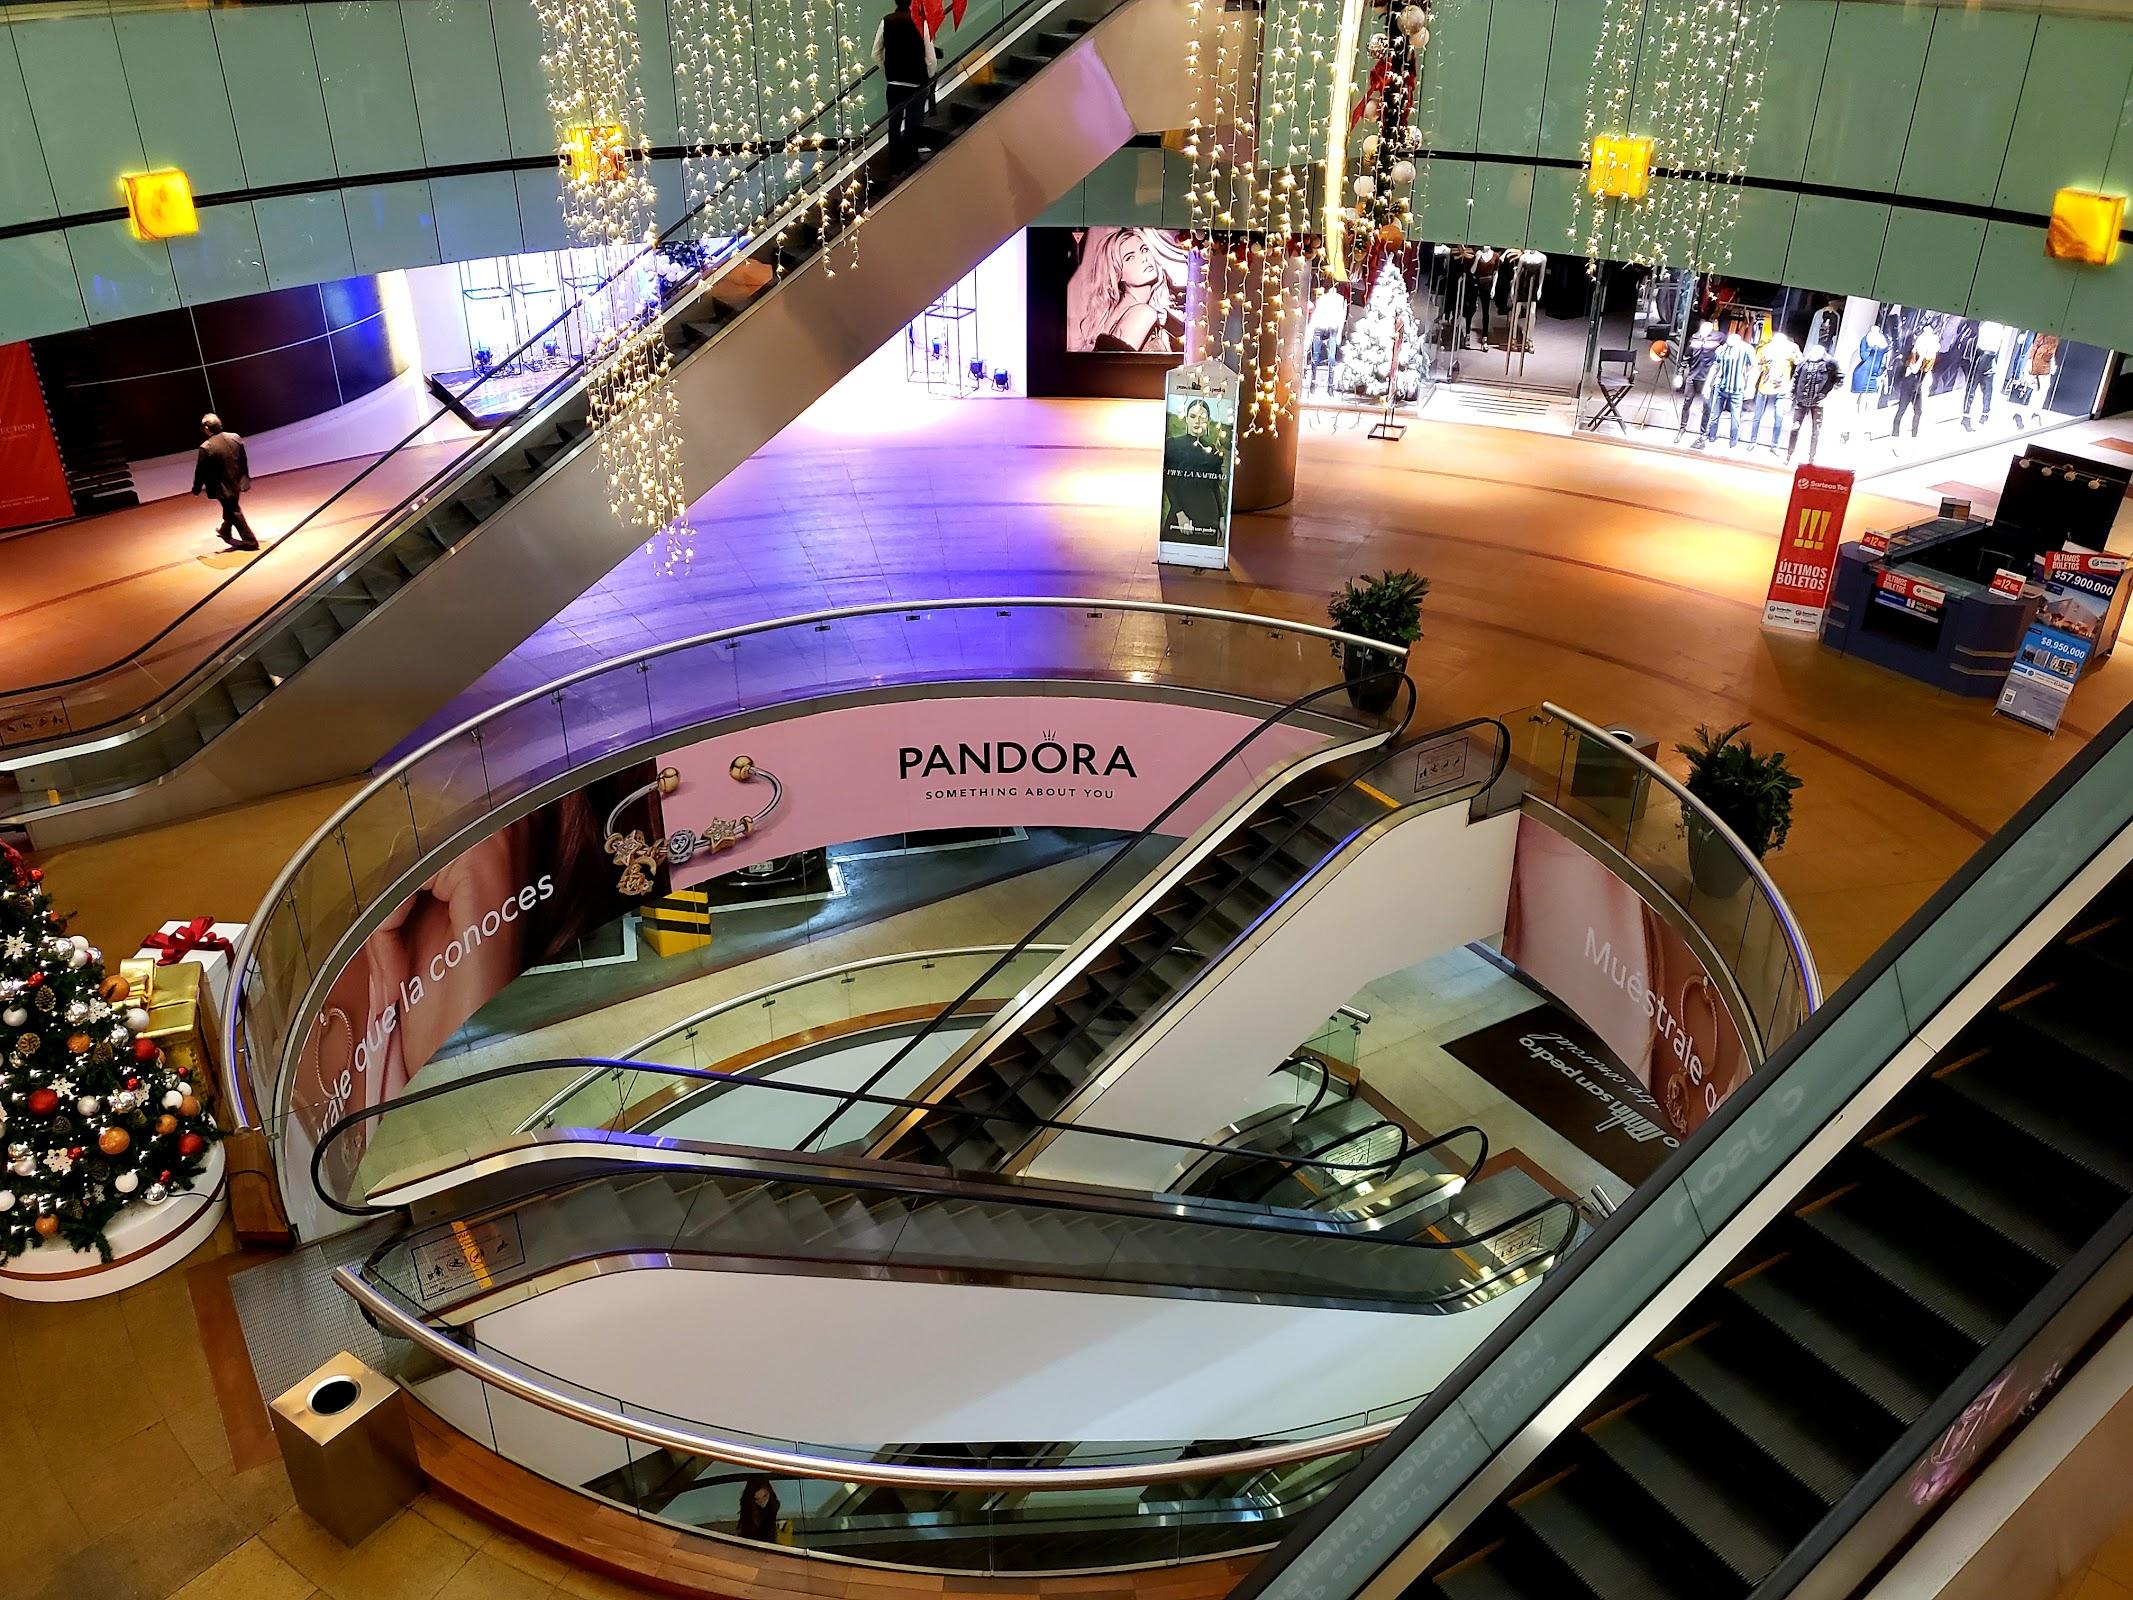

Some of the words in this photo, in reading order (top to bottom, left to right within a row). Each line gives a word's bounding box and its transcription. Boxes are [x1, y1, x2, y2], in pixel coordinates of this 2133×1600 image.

[1779, 558, 1828, 579] ÚLTIMOS
[2052, 561, 2080, 571] BOLETOS
[1776, 572, 1826, 591] BOLETOS
[2041, 637, 2085, 659] $8,950,000
[899, 741, 1138, 780] PANDORA
[925, 787, 1018, 800] SOMETHING
[1025, 787, 1076, 797] ABOUT
[1084, 789, 1115, 799] YOU
[354, 1003, 398, 1073] que
[400, 974, 425, 1013] la
[429, 874, 555, 982] conoces
[1585, 926, 1703, 1086] Muéstrale
[1519, 1037, 1583, 1079] pedro
[1526, 1033, 1627, 1083] comercial
[1575, 1075, 1615, 1103] san
